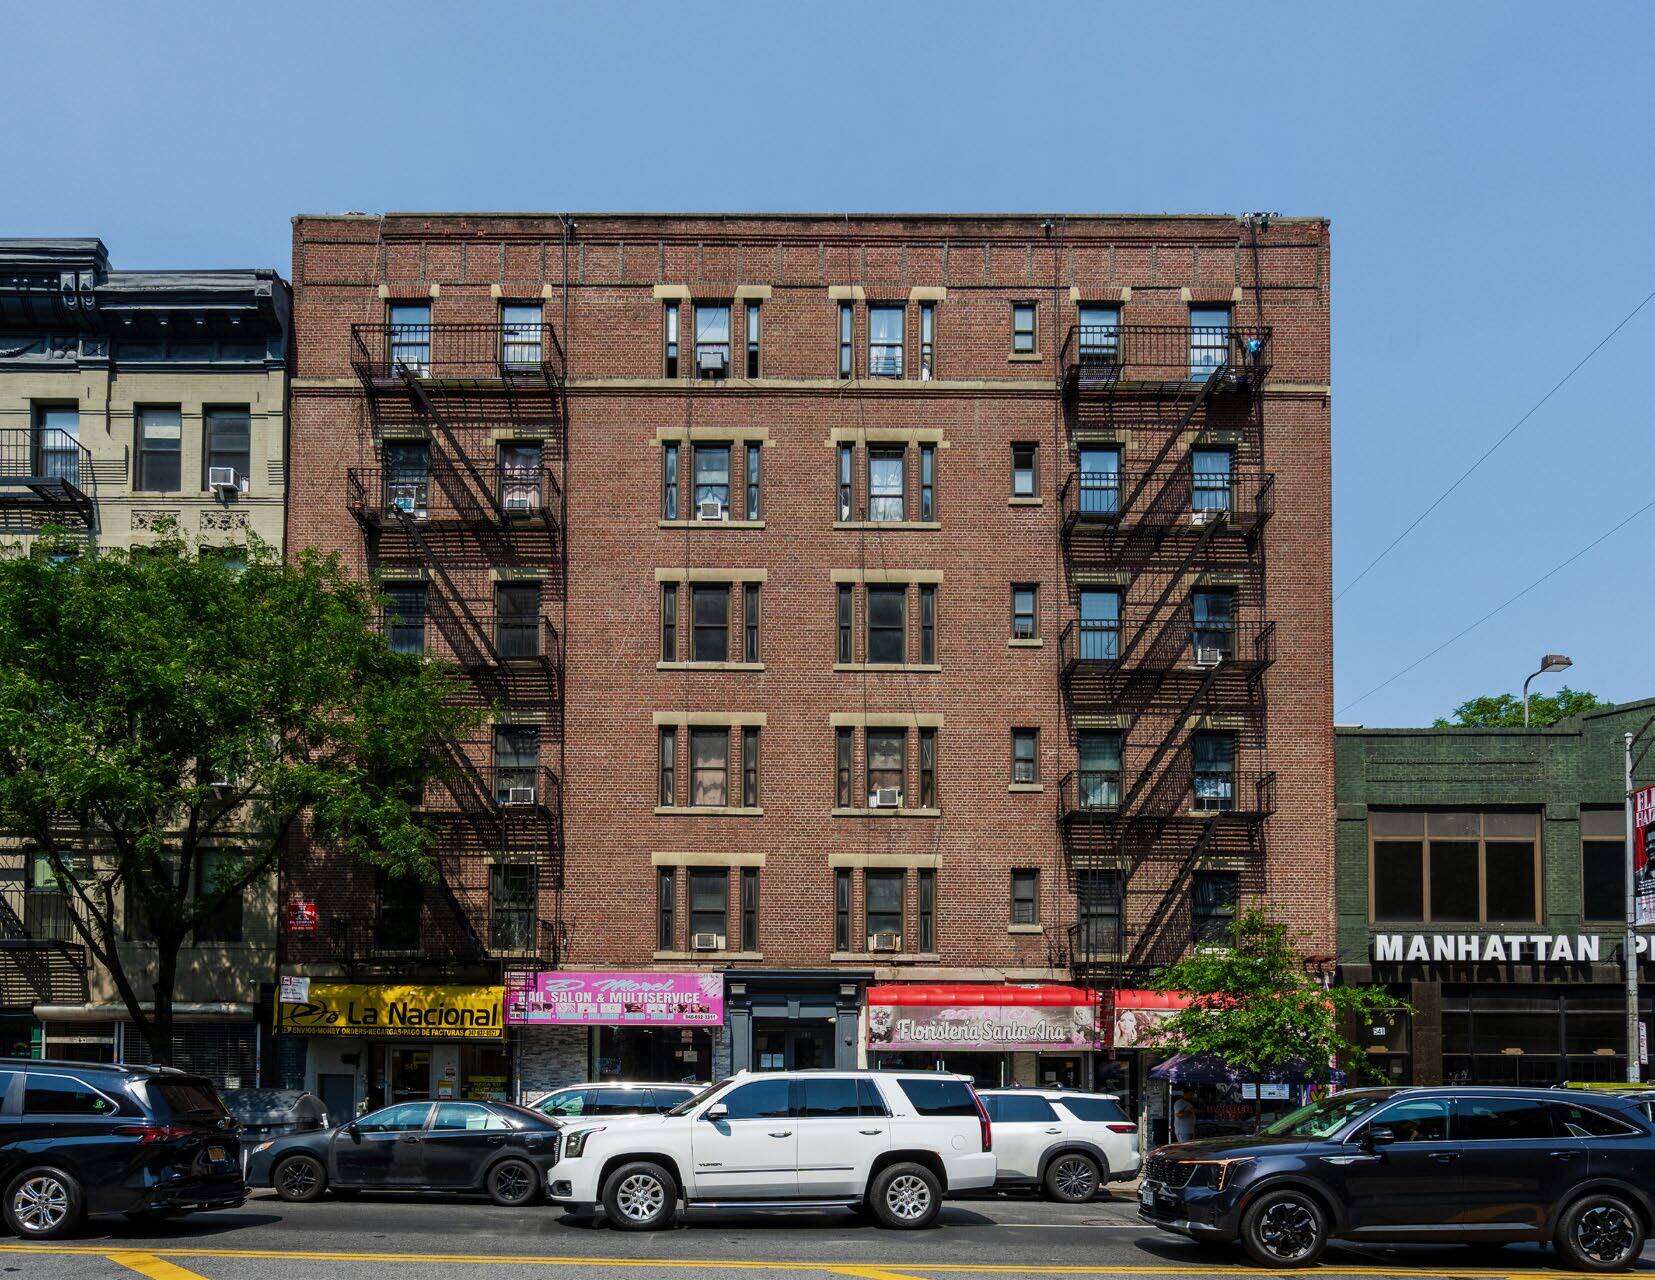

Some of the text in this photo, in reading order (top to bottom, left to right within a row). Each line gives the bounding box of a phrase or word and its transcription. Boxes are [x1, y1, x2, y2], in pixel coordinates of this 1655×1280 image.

[1375, 934, 1600, 961] MANHATTAN
[551, 992, 592, 1003] SALON
[597, 993, 605, 1003] &
[609, 992, 700, 1004] MULTISERVICE
[348, 1001, 498, 1026] La Nacional
[896, 1018, 1066, 1041] Floristería Santa Ana
